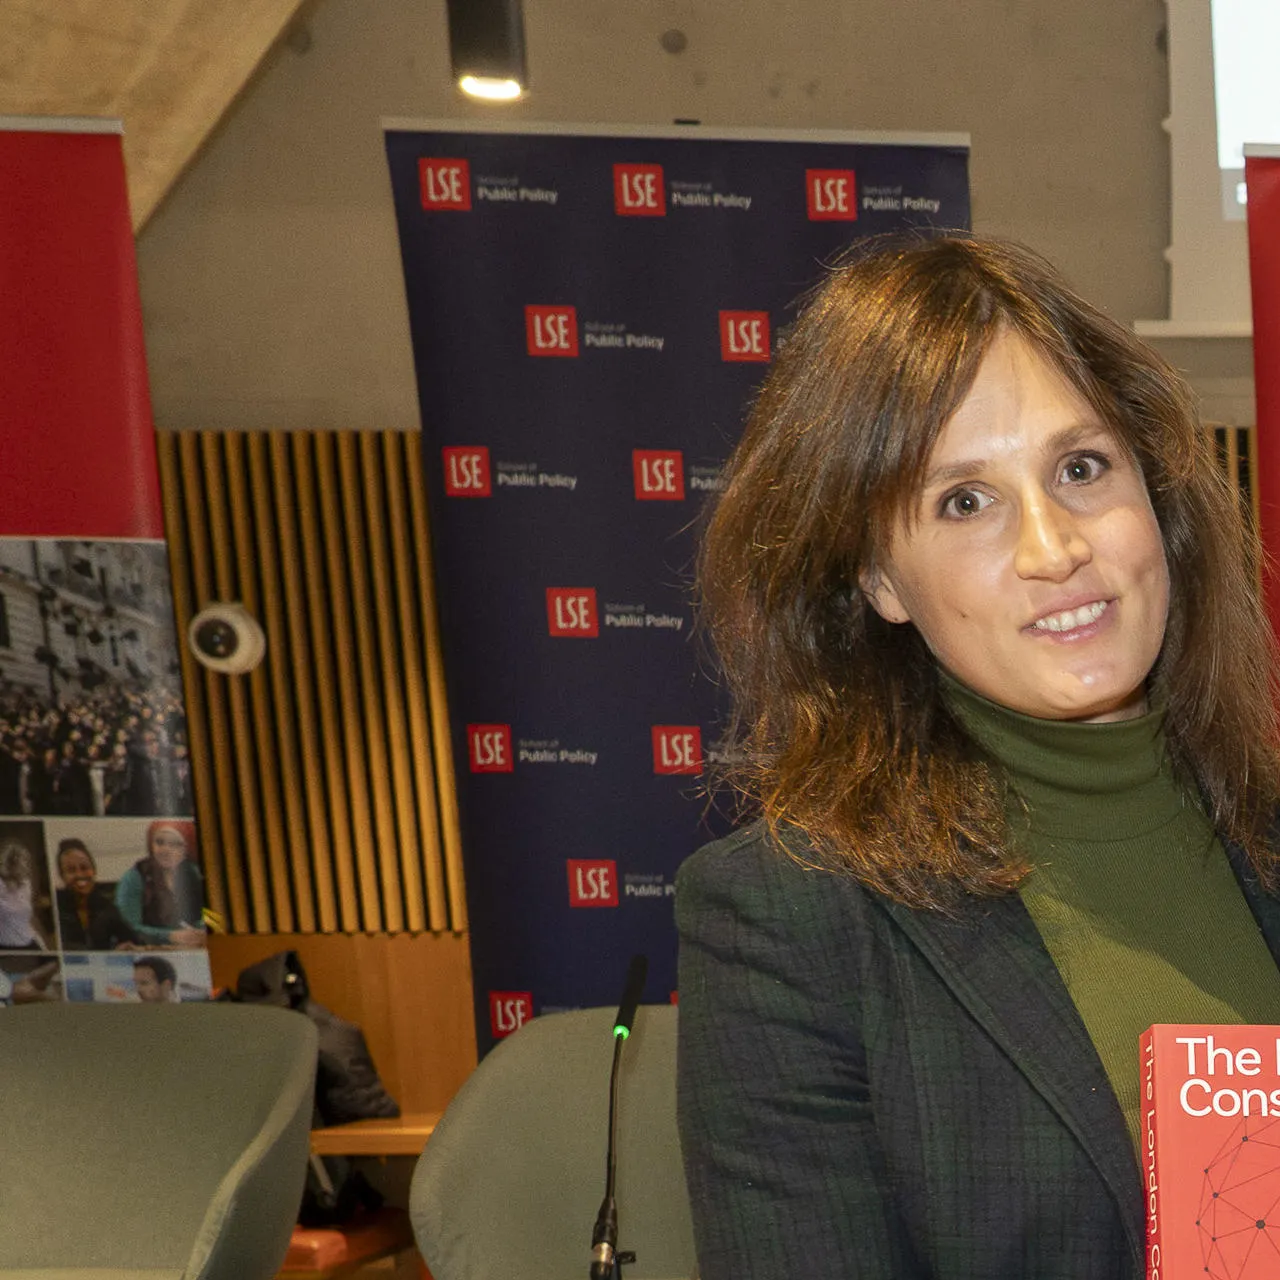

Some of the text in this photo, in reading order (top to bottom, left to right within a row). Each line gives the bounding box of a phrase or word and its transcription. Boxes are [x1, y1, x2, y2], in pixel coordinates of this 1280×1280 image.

[426, 167, 462, 202] LSE
[622, 173, 658, 207] LSE
[672, 192, 752, 210] Public Policy
[814, 178, 849, 212] LSE
[863, 197, 940, 213] Public Policy
[534, 314, 570, 348] LSE
[728, 320, 763, 353] LSE
[451, 454, 483, 488] LSE
[498, 473, 577, 490] Public Policy
[642, 458, 677, 492] LSE
[555, 596, 591, 629] LSE
[605, 615, 683, 630] Public Policy
[474, 732, 505, 765] LSE
[519, 750, 598, 766] Public Policy
[660, 733, 694, 767] LSE
[576, 867, 611, 900] LSE
[625, 884, 663, 897] Public
[1146, 1036, 1154, 1100] The
[1176, 1035, 1261, 1076] The
[1147, 1110, 1158, 1234] London
